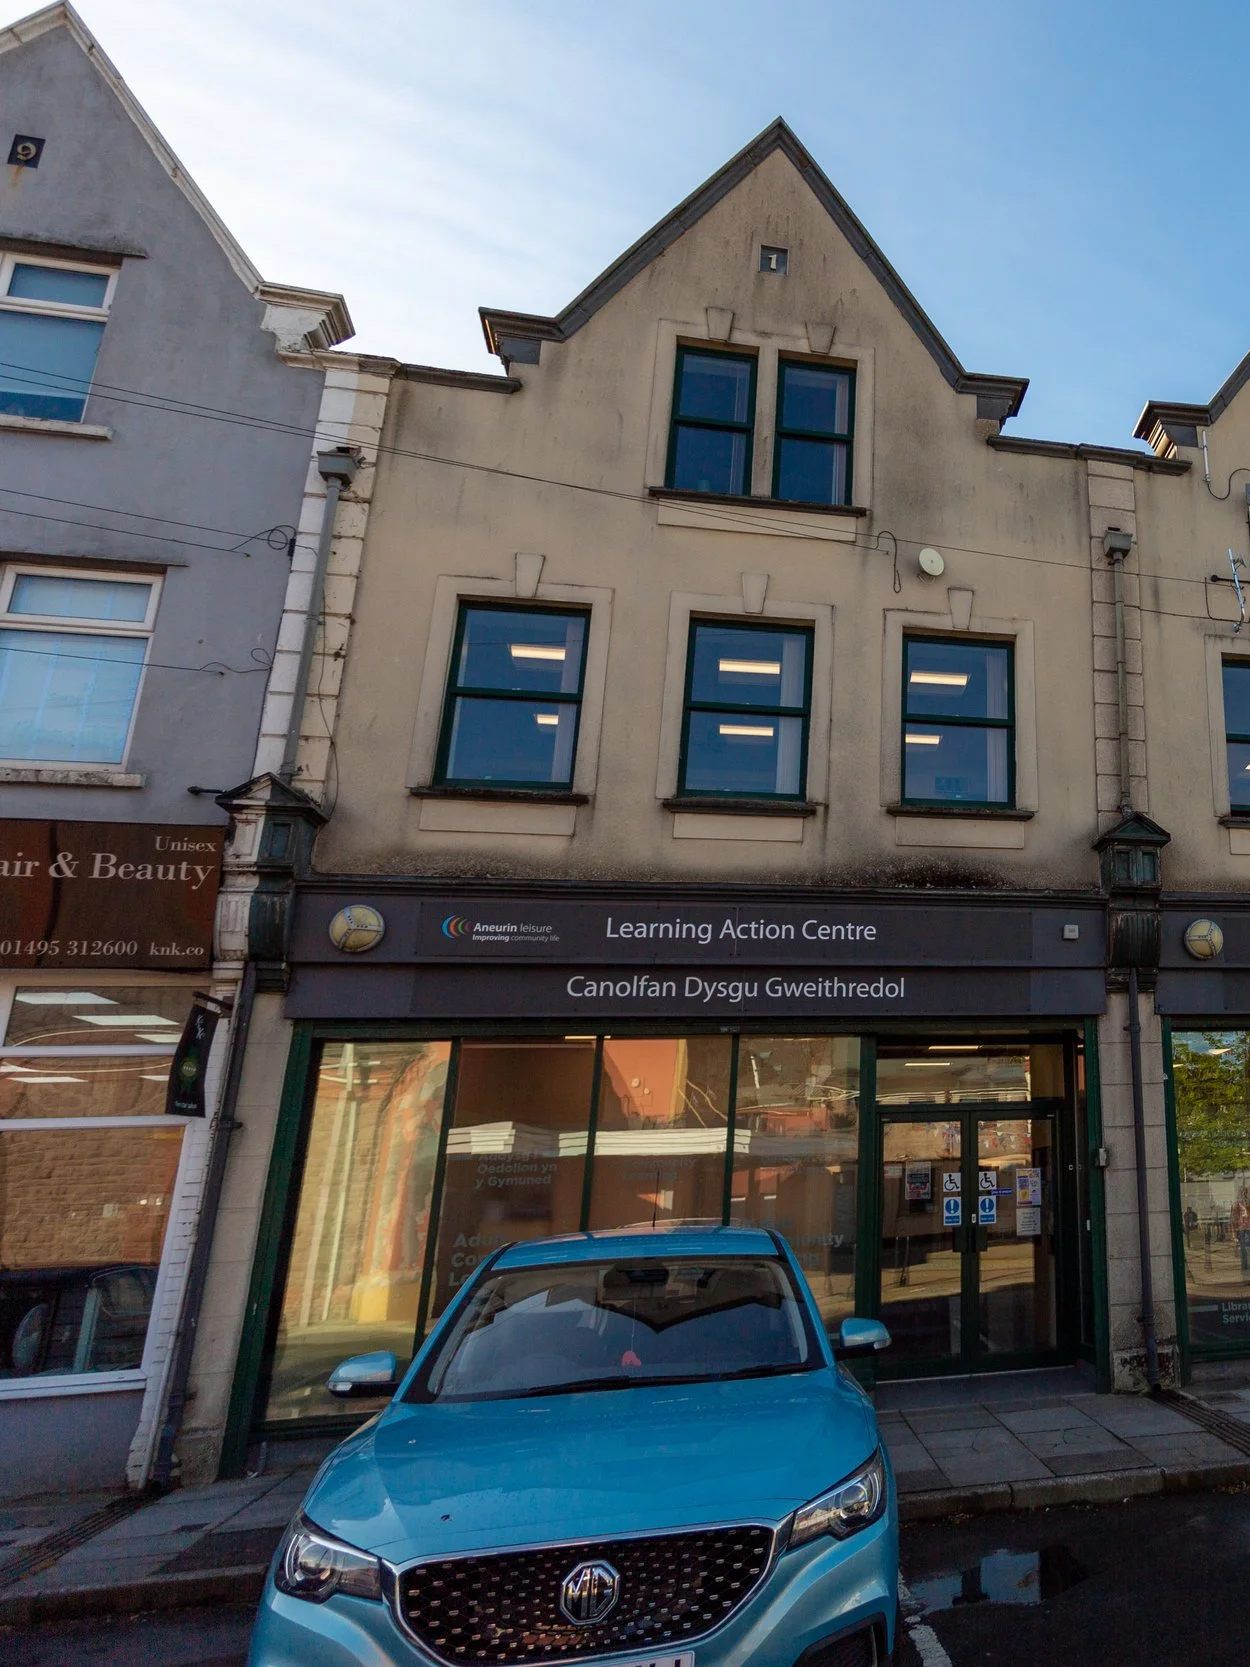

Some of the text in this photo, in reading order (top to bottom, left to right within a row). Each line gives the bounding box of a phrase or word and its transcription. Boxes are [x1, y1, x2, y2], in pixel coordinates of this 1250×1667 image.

[17, 142, 37, 161] 9
[768, 254, 777, 270] 1
[155, 836, 217, 852] Unisex
[48, 852, 79, 878] &
[88, 852, 215, 890] Beauty
[473, 922, 553, 933] Aneurin leisure
[606, 917, 877, 944] Learning Action Centre
[472, 934, 510, 943] Improving
[510, 934, 549, 943] community
[1, 940, 204, 956] 01495 312600 knk.co
[567, 976, 905, 1002] Canolfan Dysgu Gweithredol
[488, 1174, 552, 1188] Gymuned
[567, 1567, 613, 1618] MG
